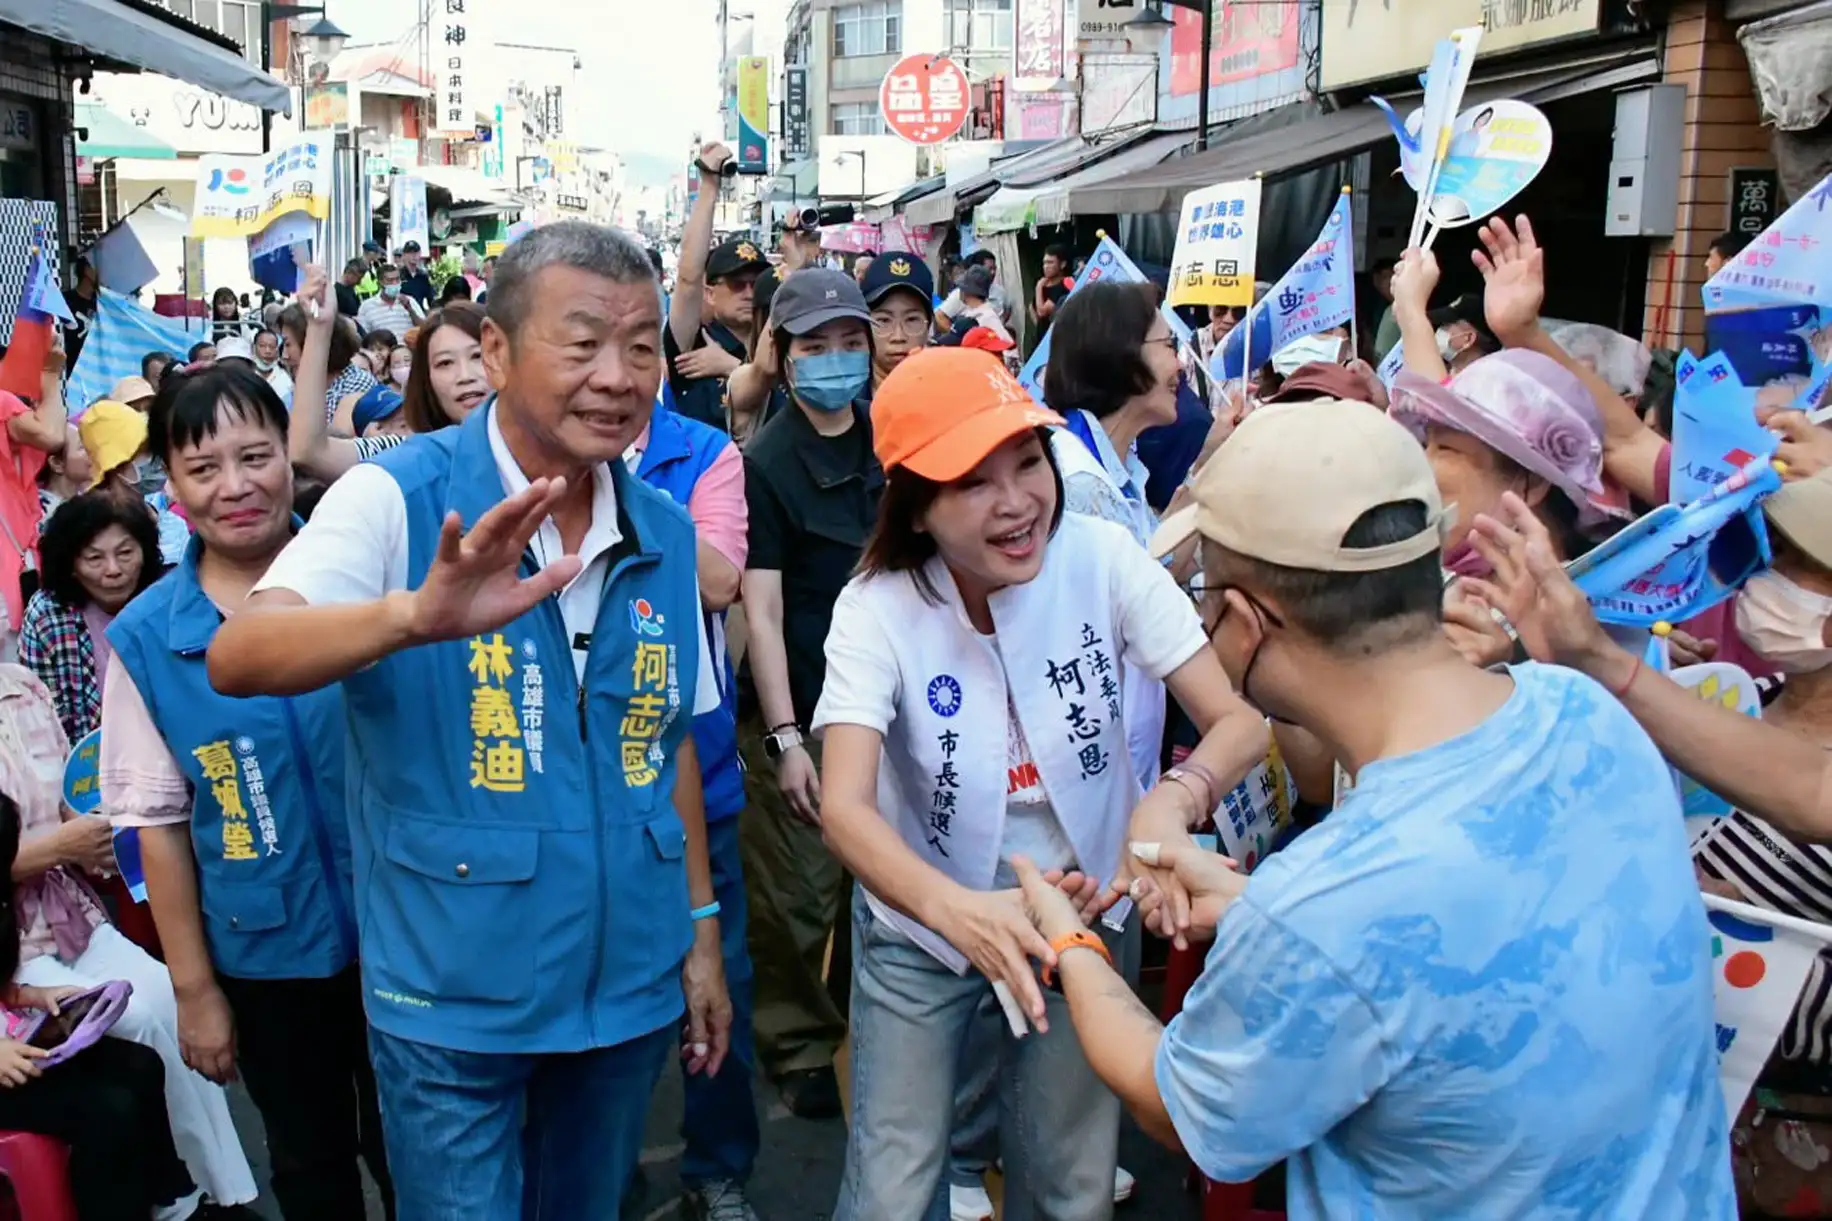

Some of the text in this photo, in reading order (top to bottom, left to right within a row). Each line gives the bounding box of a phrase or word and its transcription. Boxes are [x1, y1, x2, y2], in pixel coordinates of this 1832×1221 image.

[468, 633, 526, 792] 林義迪
[521, 662, 544, 774] 高雄市議員
[619, 640, 668, 788] 柯志恩
[1045, 658, 1110, 781] 柯志恩
[1081, 623, 1122, 723] 立法委員
[927, 729, 961, 858] 市長候選人
